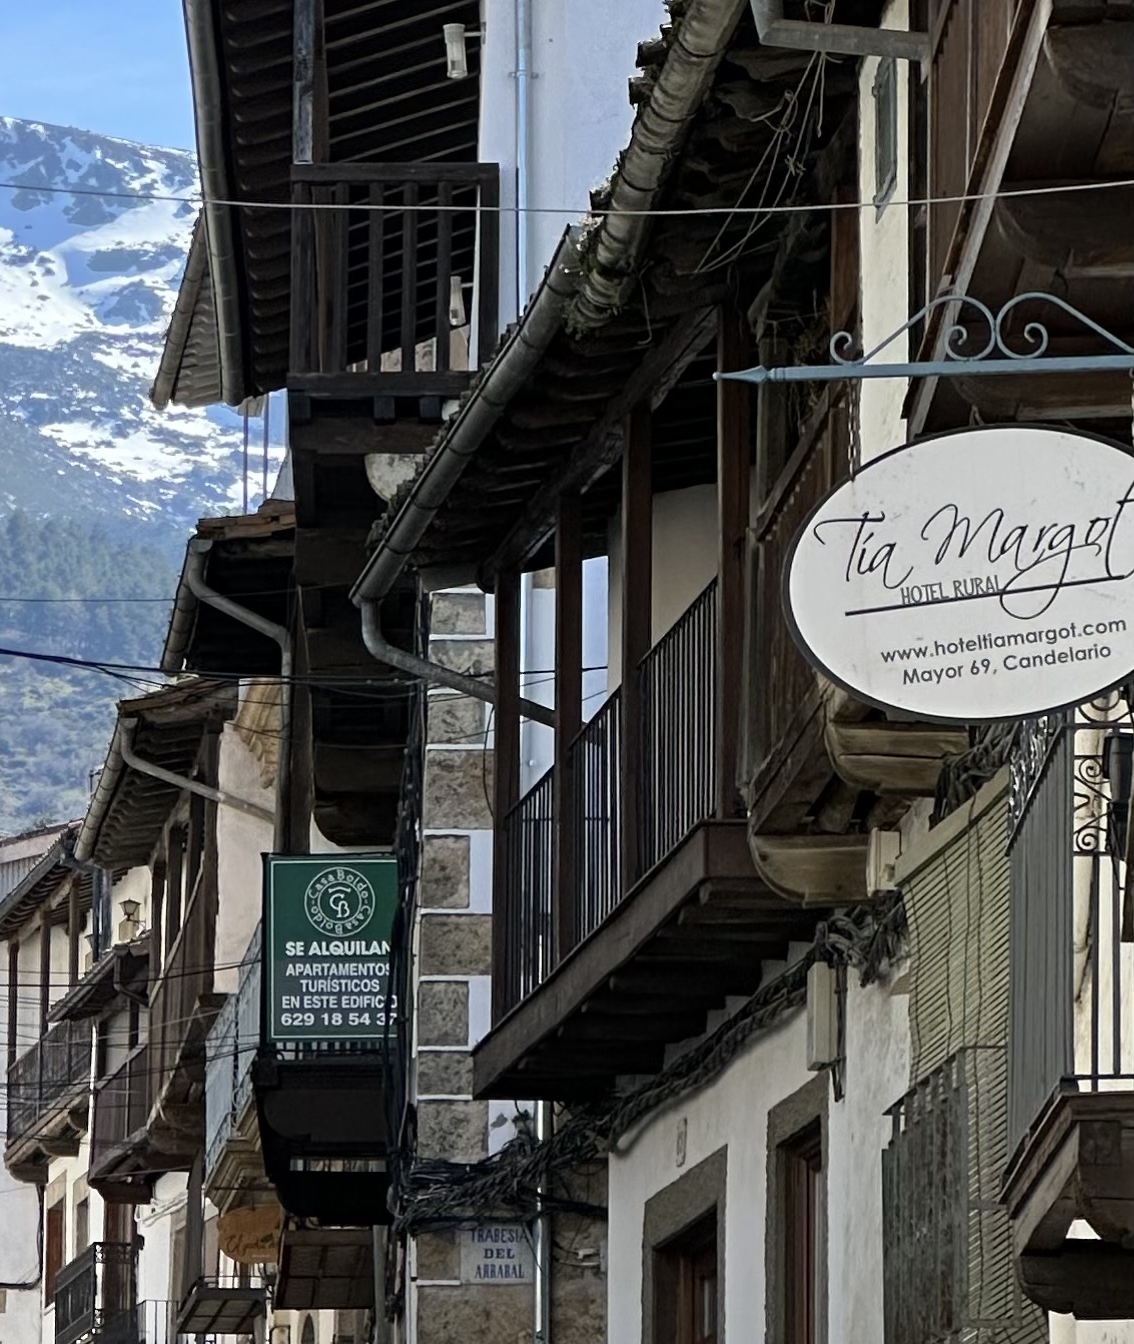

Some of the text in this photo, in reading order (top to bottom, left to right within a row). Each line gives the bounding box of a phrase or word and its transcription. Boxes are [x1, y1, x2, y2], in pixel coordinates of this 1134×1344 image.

[921, 481, 1134, 620] Margot
[901, 574, 1003, 605] HOTEL RURAL
[881, 618, 1127, 663] www.hoteltiamargot.com
[903, 643, 1111, 685] Mayor 69, Candelario
[285, 940, 391, 956] SE ALQUILAN
[300, 976, 380, 992] TURÍSTICOS
[281, 995, 398, 1009] EN ESTE EDIFICO
[281, 1012, 398, 1026] 629 18 54 37
[483, 1248, 516, 1260] DEL
[474, 1264, 525, 1279] ARRABAL
